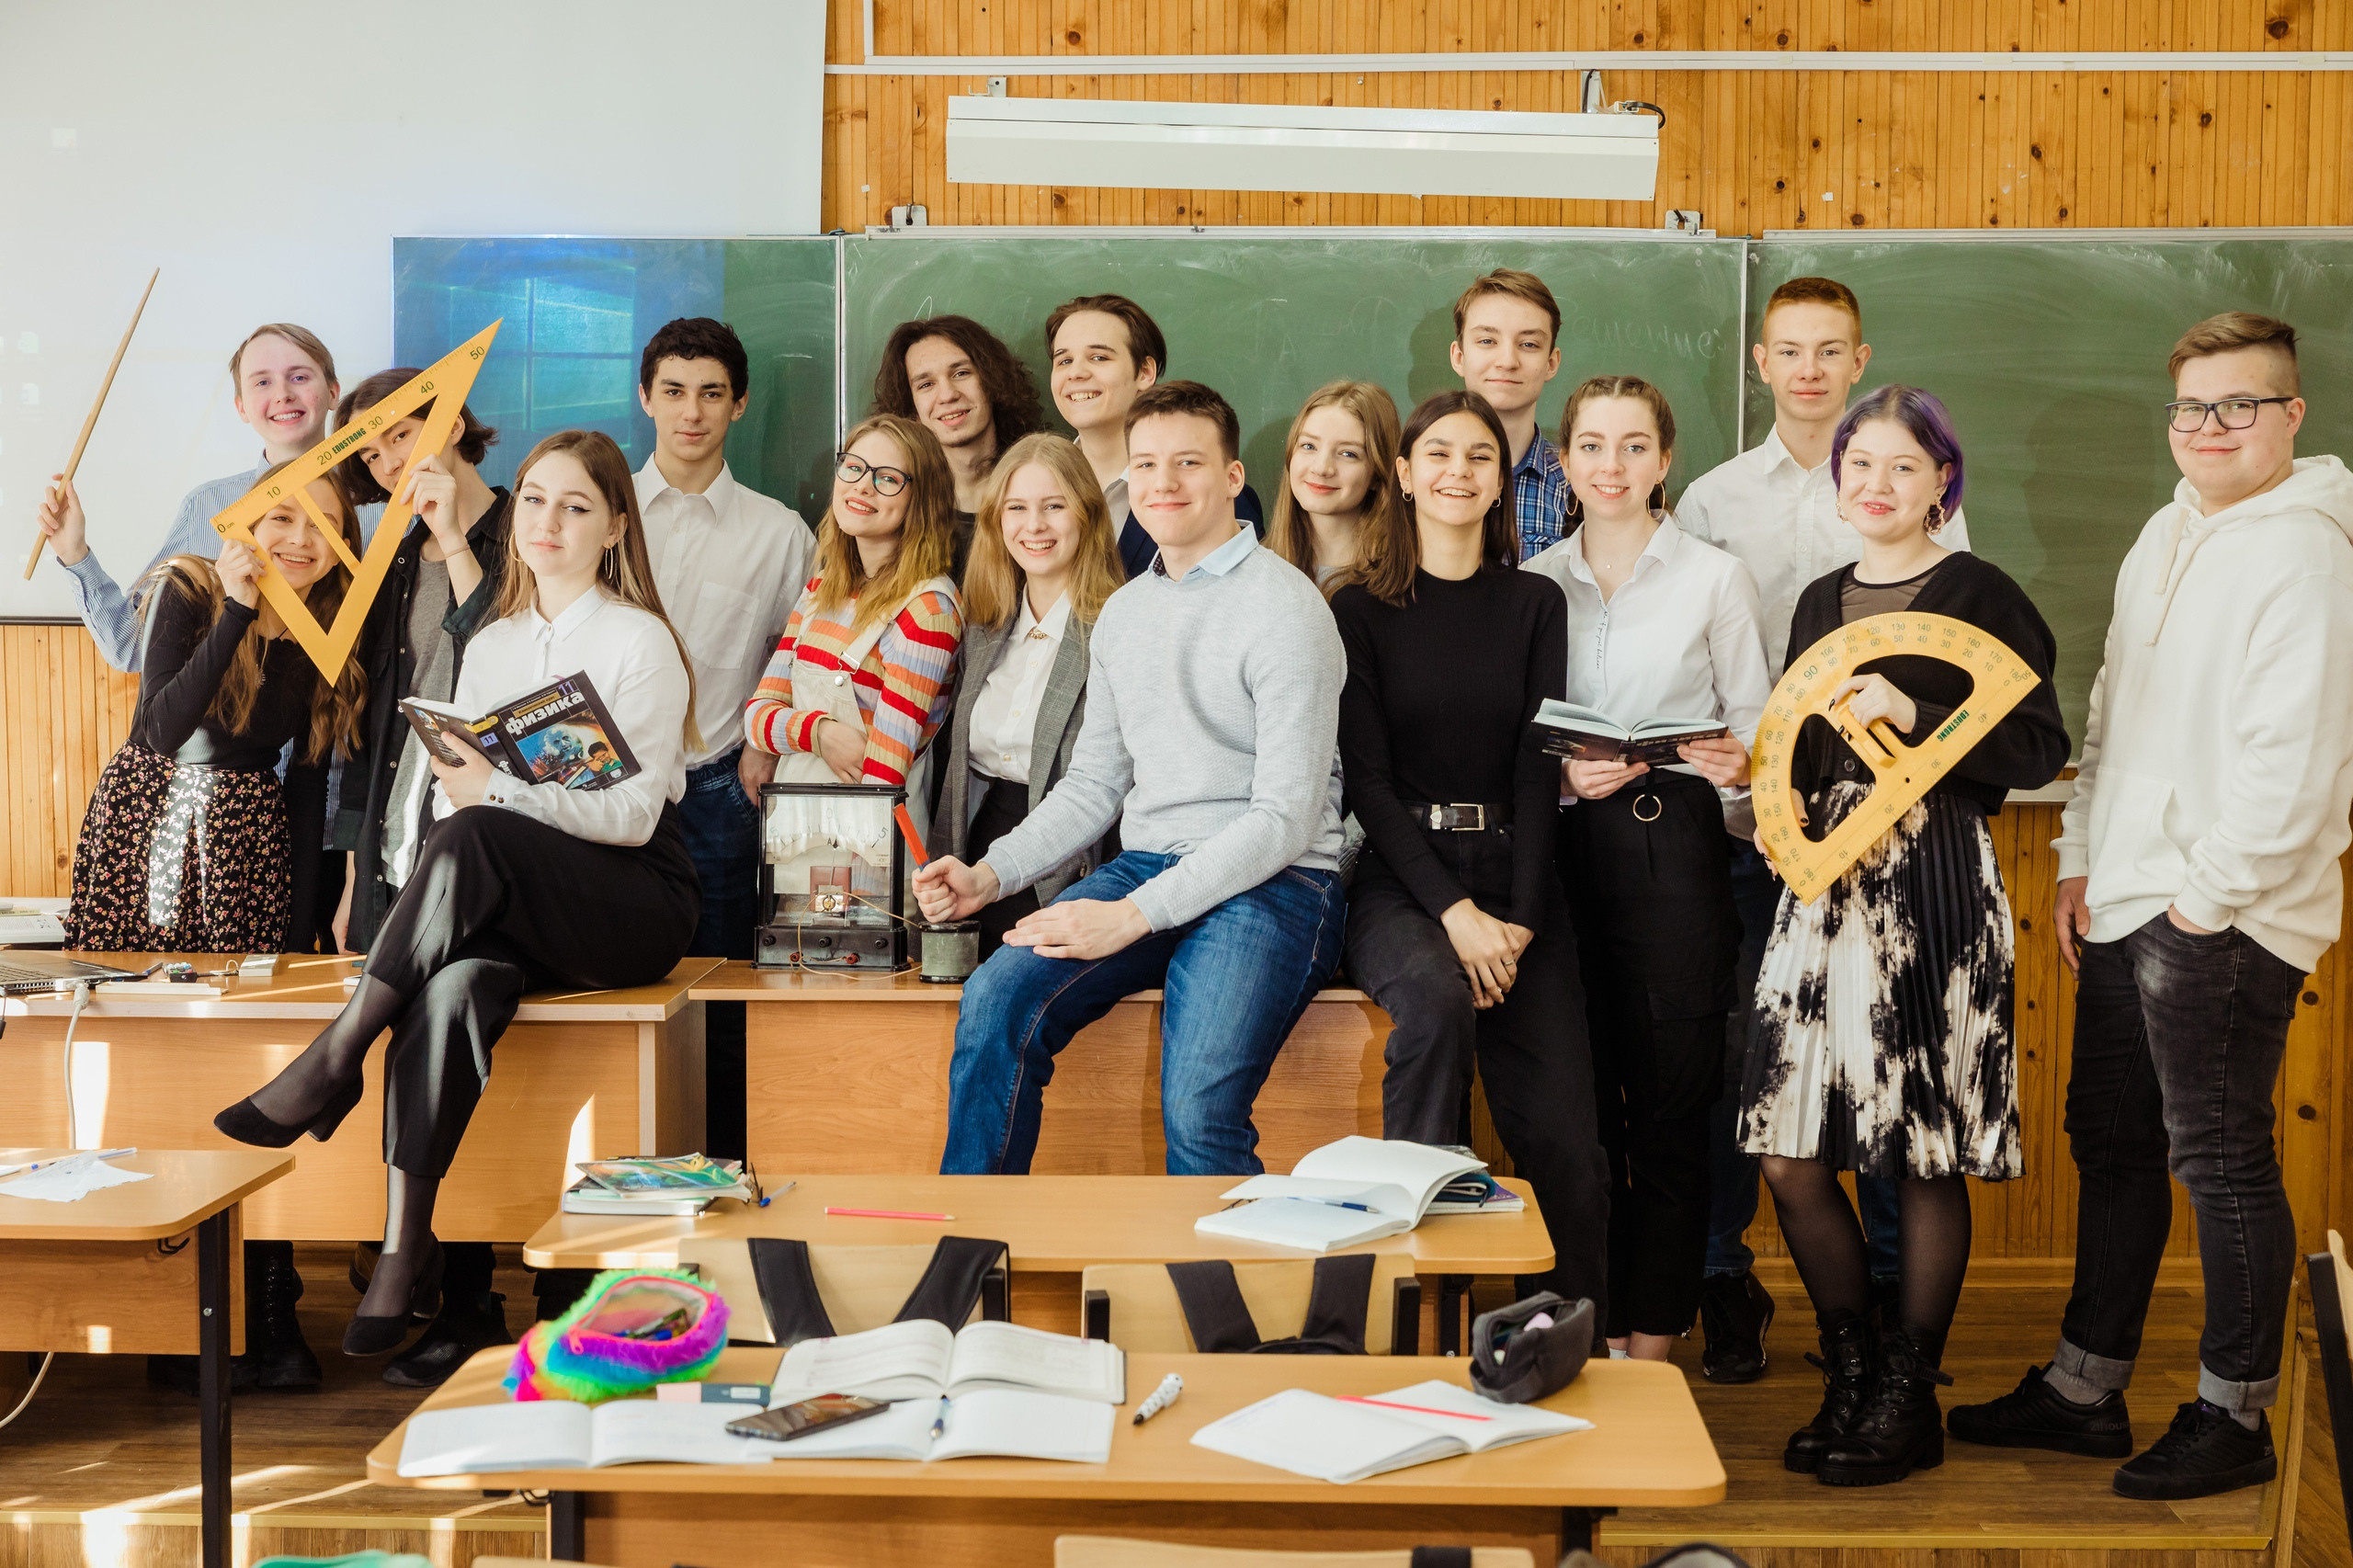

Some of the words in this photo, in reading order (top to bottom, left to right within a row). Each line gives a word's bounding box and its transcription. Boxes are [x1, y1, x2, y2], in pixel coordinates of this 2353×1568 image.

[469, 346, 485, 360] 50
[420, 381, 435, 395] 40
[368, 415, 384, 430] 30
[332, 426, 368, 454] EDUSTRONG
[316, 450, 333, 466] 20
[267, 485, 281, 500] 10
[217, 522, 226, 533] 0
[1866, 626, 1881, 636] 120
[1892, 622, 1905, 631] 130
[1917, 623, 1931, 632] 140
[1893, 634, 1904, 643] 50
[1942, 628, 1957, 638] 150
[1842, 634, 1857, 646] 110
[1870, 638, 1881, 647] 60
[1917, 635, 1928, 644] 40
[1941, 640, 1950, 649] 30
[1967, 637, 1981, 649] 160
[1821, 645, 1834, 658] 100
[1847, 645, 1859, 654] 70
[1962, 649, 1973, 658] 20
[1827, 656, 1838, 667] 80
[1989, 651, 2003, 664] 170
[1803, 665, 1818, 680] 90
[1984, 662, 1995, 672] 10
[2009, 669, 2022, 682] 180
[2021, 670, 2032, 680] 50
[559, 681, 575, 695] 11
[1787, 683, 1796, 694] 80
[1794, 687, 1806, 702] 100
[506, 691, 585, 735] физика
[1774, 706, 1783, 717] 70
[1783, 710, 1793, 722] 110
[1978, 713, 1988, 723] 40
[1936, 710, 1970, 743] EDUSTRONG
[483, 735, 494, 744] 11
[1765, 730, 1774, 741] 60
[1776, 731, 1785, 745] 120
[1760, 756, 1768, 766] 50
[1771, 755, 1779, 769] 130
[1930, 759, 1941, 770] 30
[1759, 781, 1768, 792] 40
[1771, 778, 1779, 793] 140
[1763, 808, 1771, 818] 30
[1884, 803, 1895, 814] 20
[879, 827, 888, 838] 5
[1780, 826, 1790, 841] 160
[1771, 833, 1779, 844] 20
[1790, 847, 1802, 862] 170
[1838, 849, 1848, 860] 10
[1782, 856, 1791, 867] 10
